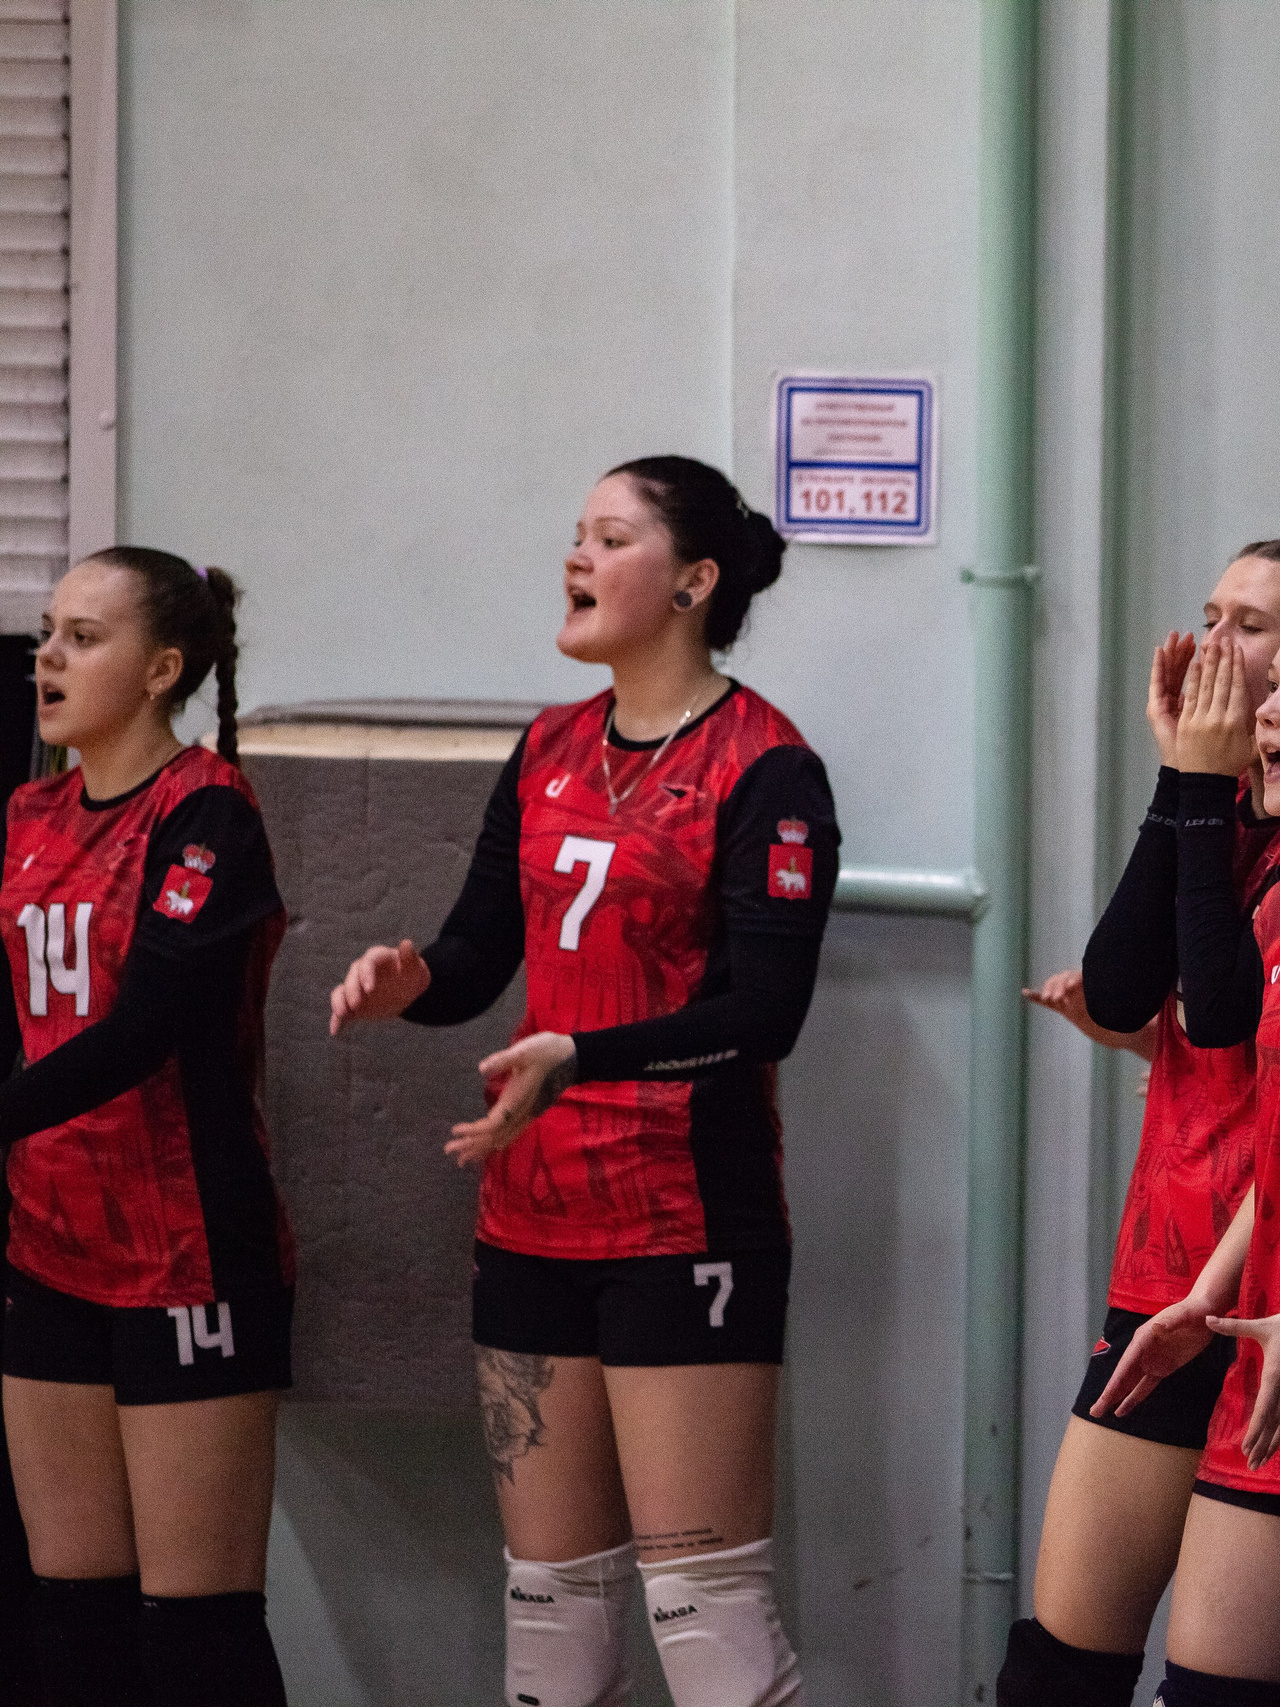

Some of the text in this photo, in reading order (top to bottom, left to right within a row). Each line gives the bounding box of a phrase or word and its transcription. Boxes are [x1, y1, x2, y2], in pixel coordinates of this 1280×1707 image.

[862, 490, 908, 515] 112
[553, 834, 616, 952] 7
[16, 902, 93, 1017] 14
[693, 1261, 734, 1327] 7
[167, 1301, 236, 1366] 14
